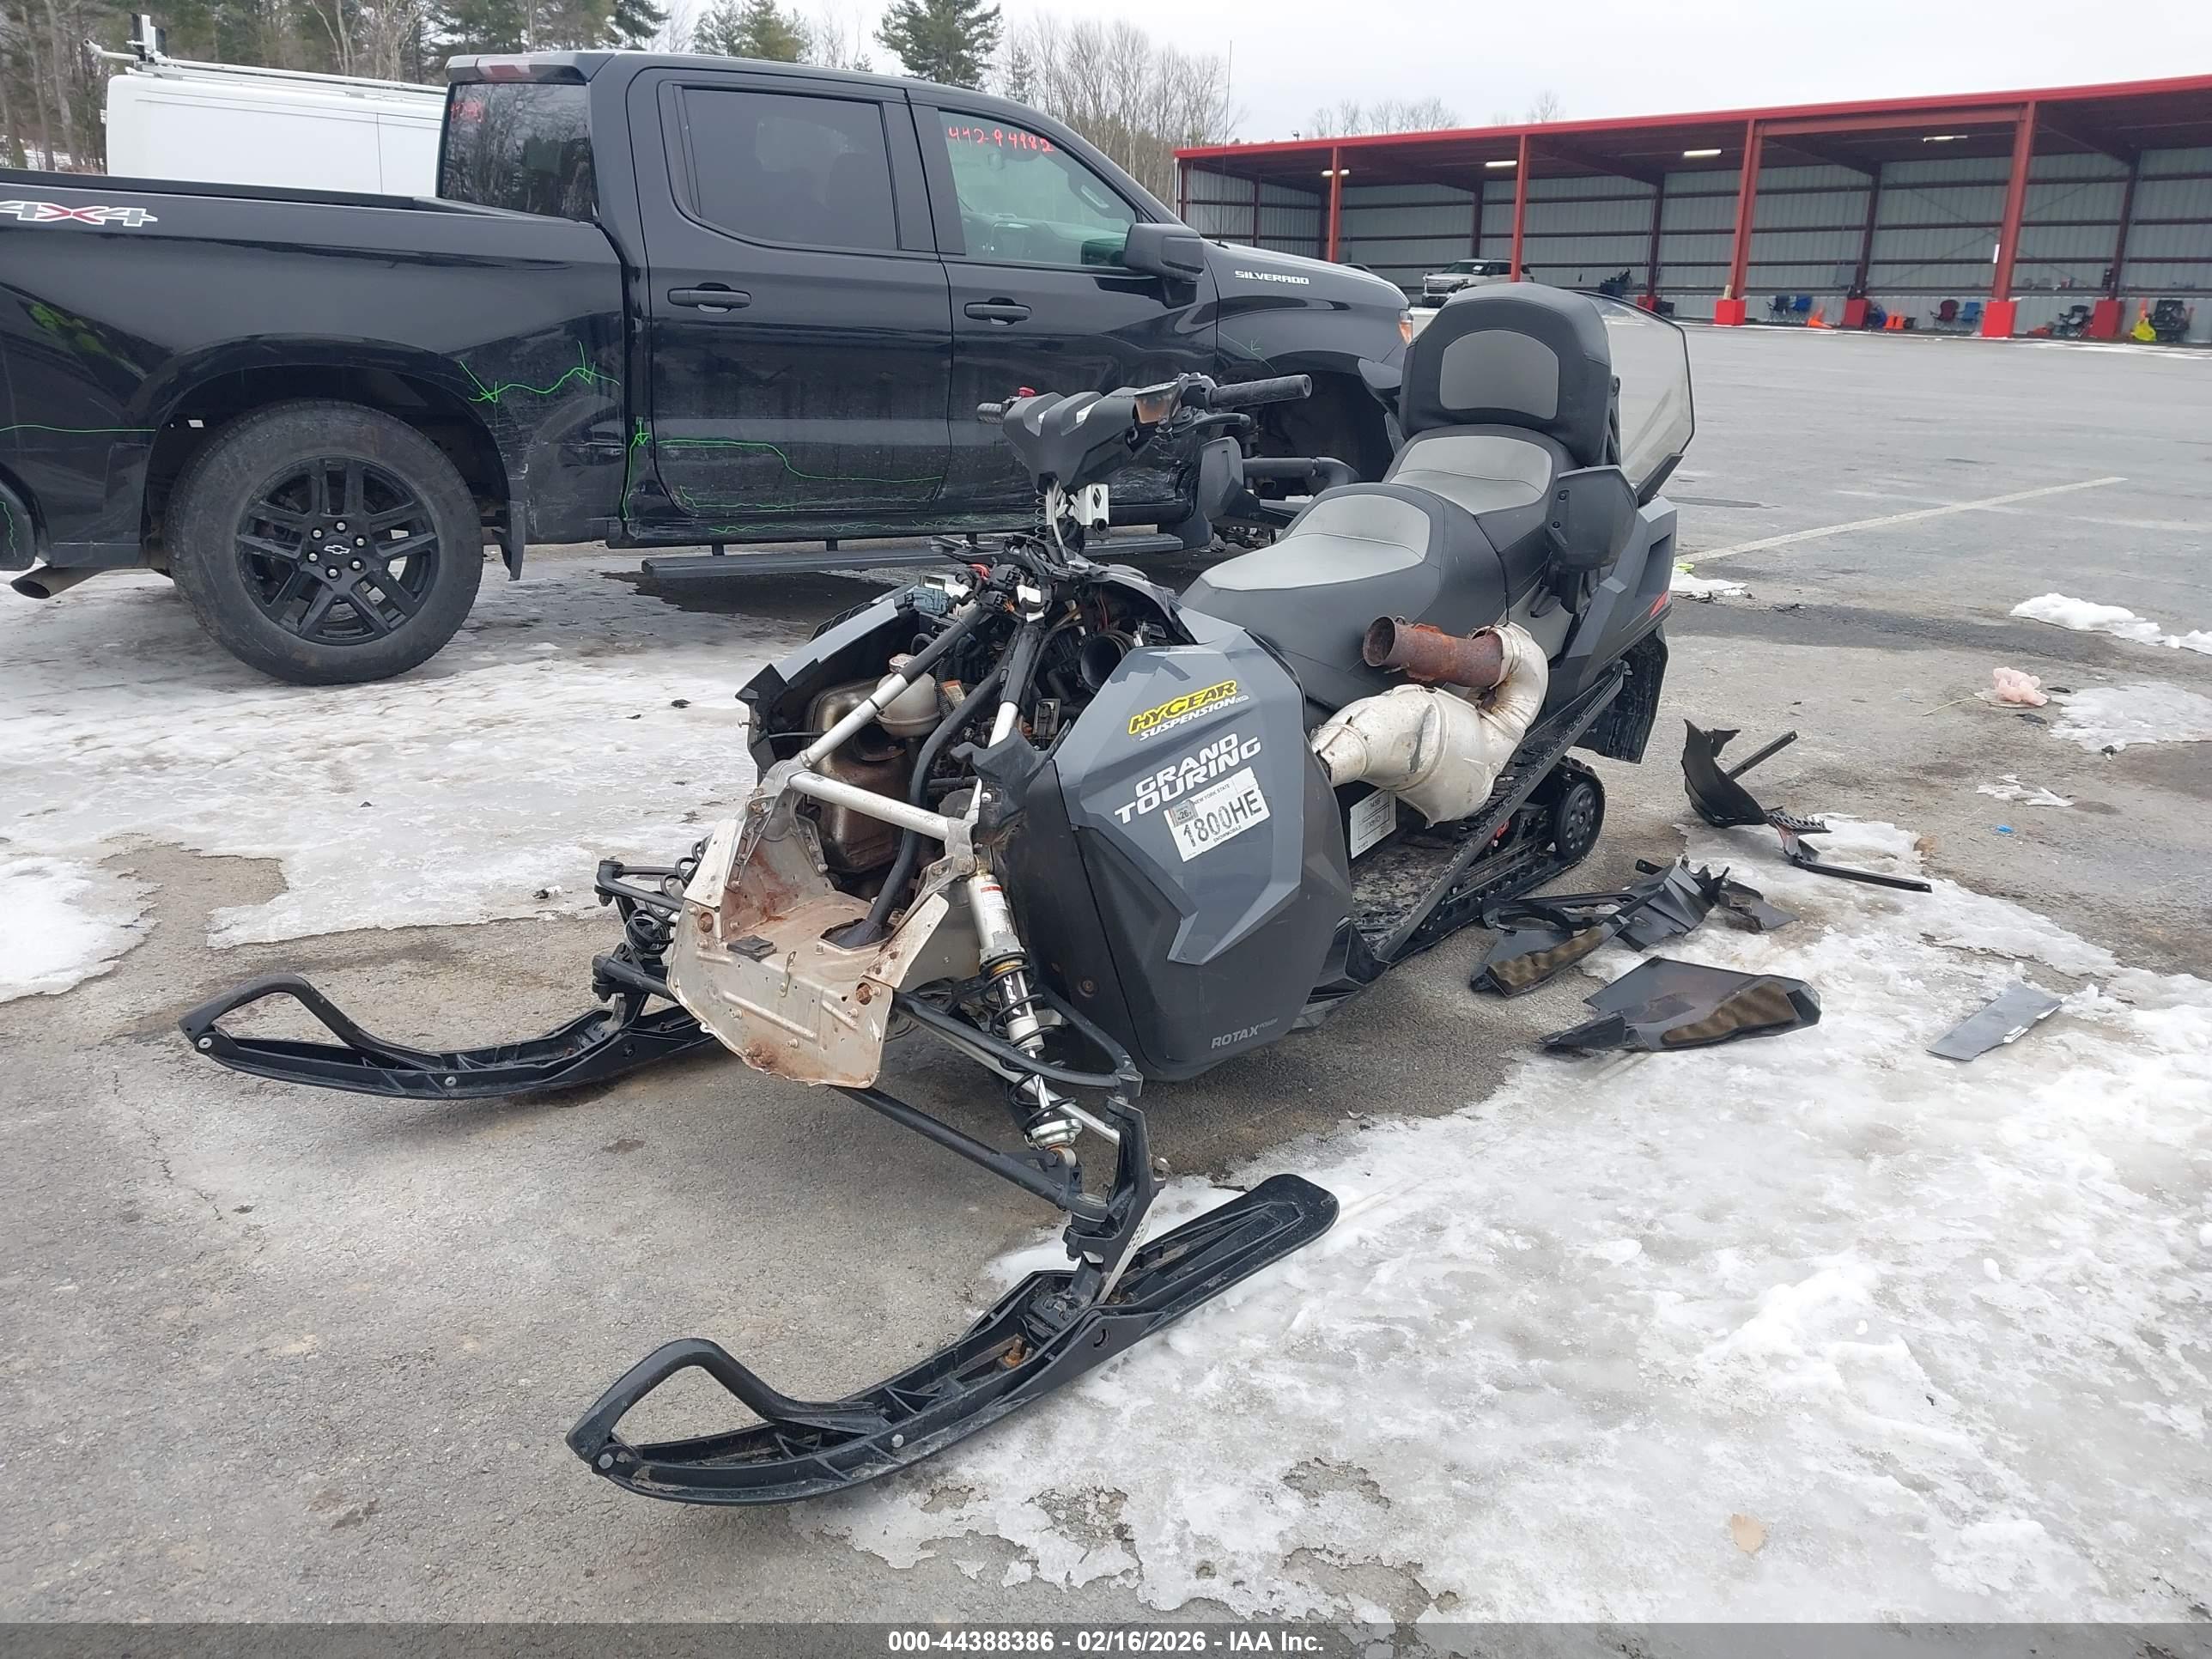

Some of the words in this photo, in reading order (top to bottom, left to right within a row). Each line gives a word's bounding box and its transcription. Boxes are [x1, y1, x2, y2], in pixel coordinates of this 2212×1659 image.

[1234, 270, 1310, 285] SILVERADO
[1128, 679, 1237, 735] HYGEAR
[1114, 736, 1262, 824] TOURING
[1135, 732, 1239, 798] GRAND
[1204, 790, 1217, 800] YORK
[1217, 783, 1231, 795] STATE
[1183, 789, 1262, 848] 1800HE
[1212, 824, 1243, 843] SNOWMOBILE
[1211, 1024, 1260, 1049] ROTAX
